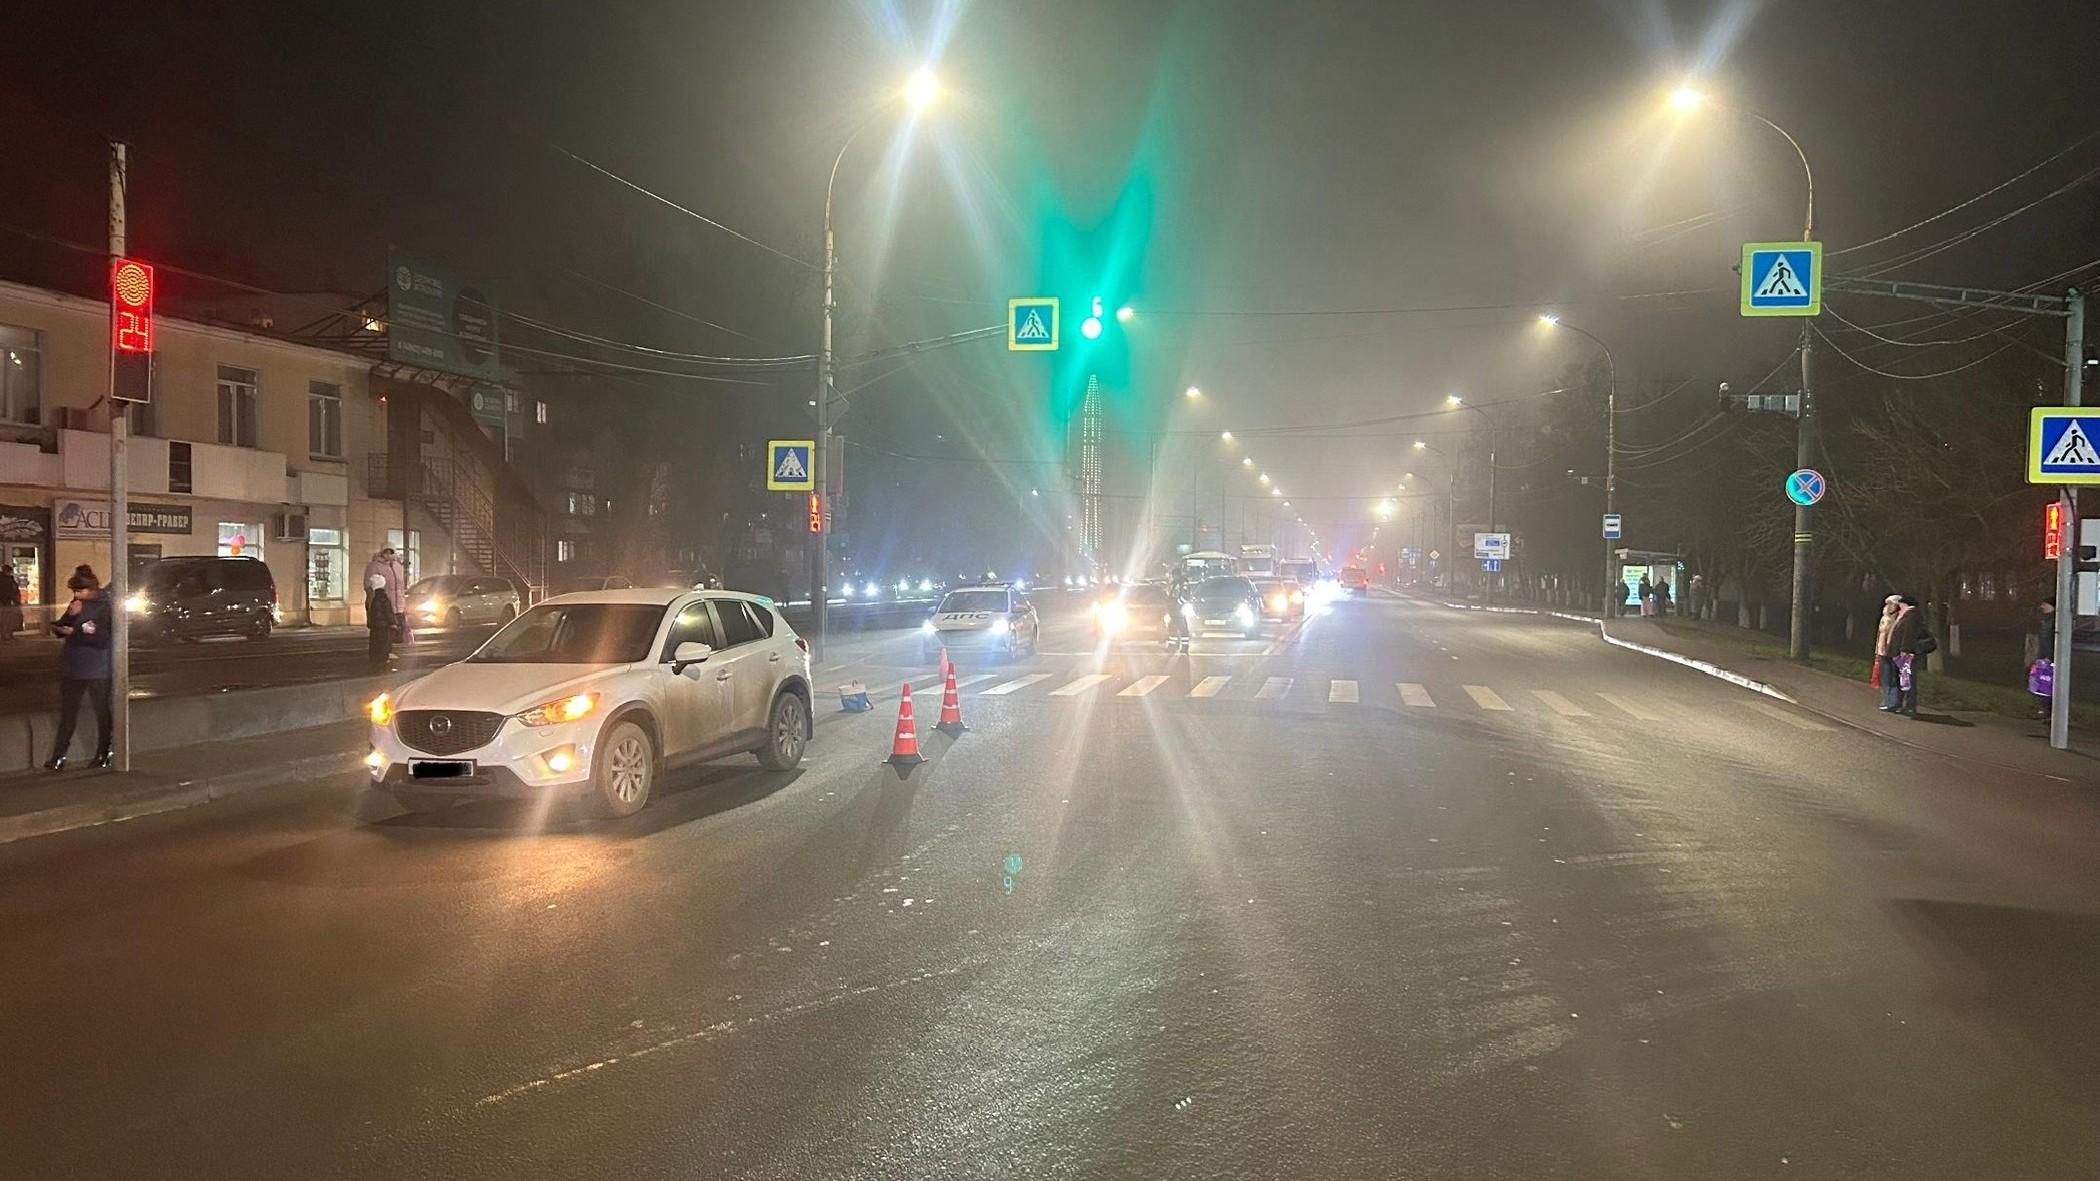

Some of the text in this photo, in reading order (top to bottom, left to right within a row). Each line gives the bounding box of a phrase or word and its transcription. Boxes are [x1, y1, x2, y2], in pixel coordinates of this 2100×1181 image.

[1092, 295, 1104, 317] 6
[119, 311, 150, 352] 24
[125, 513, 189, 529] ВЕЛИР-ГРАВЕР
[942, 613, 990, 621] ДПС
